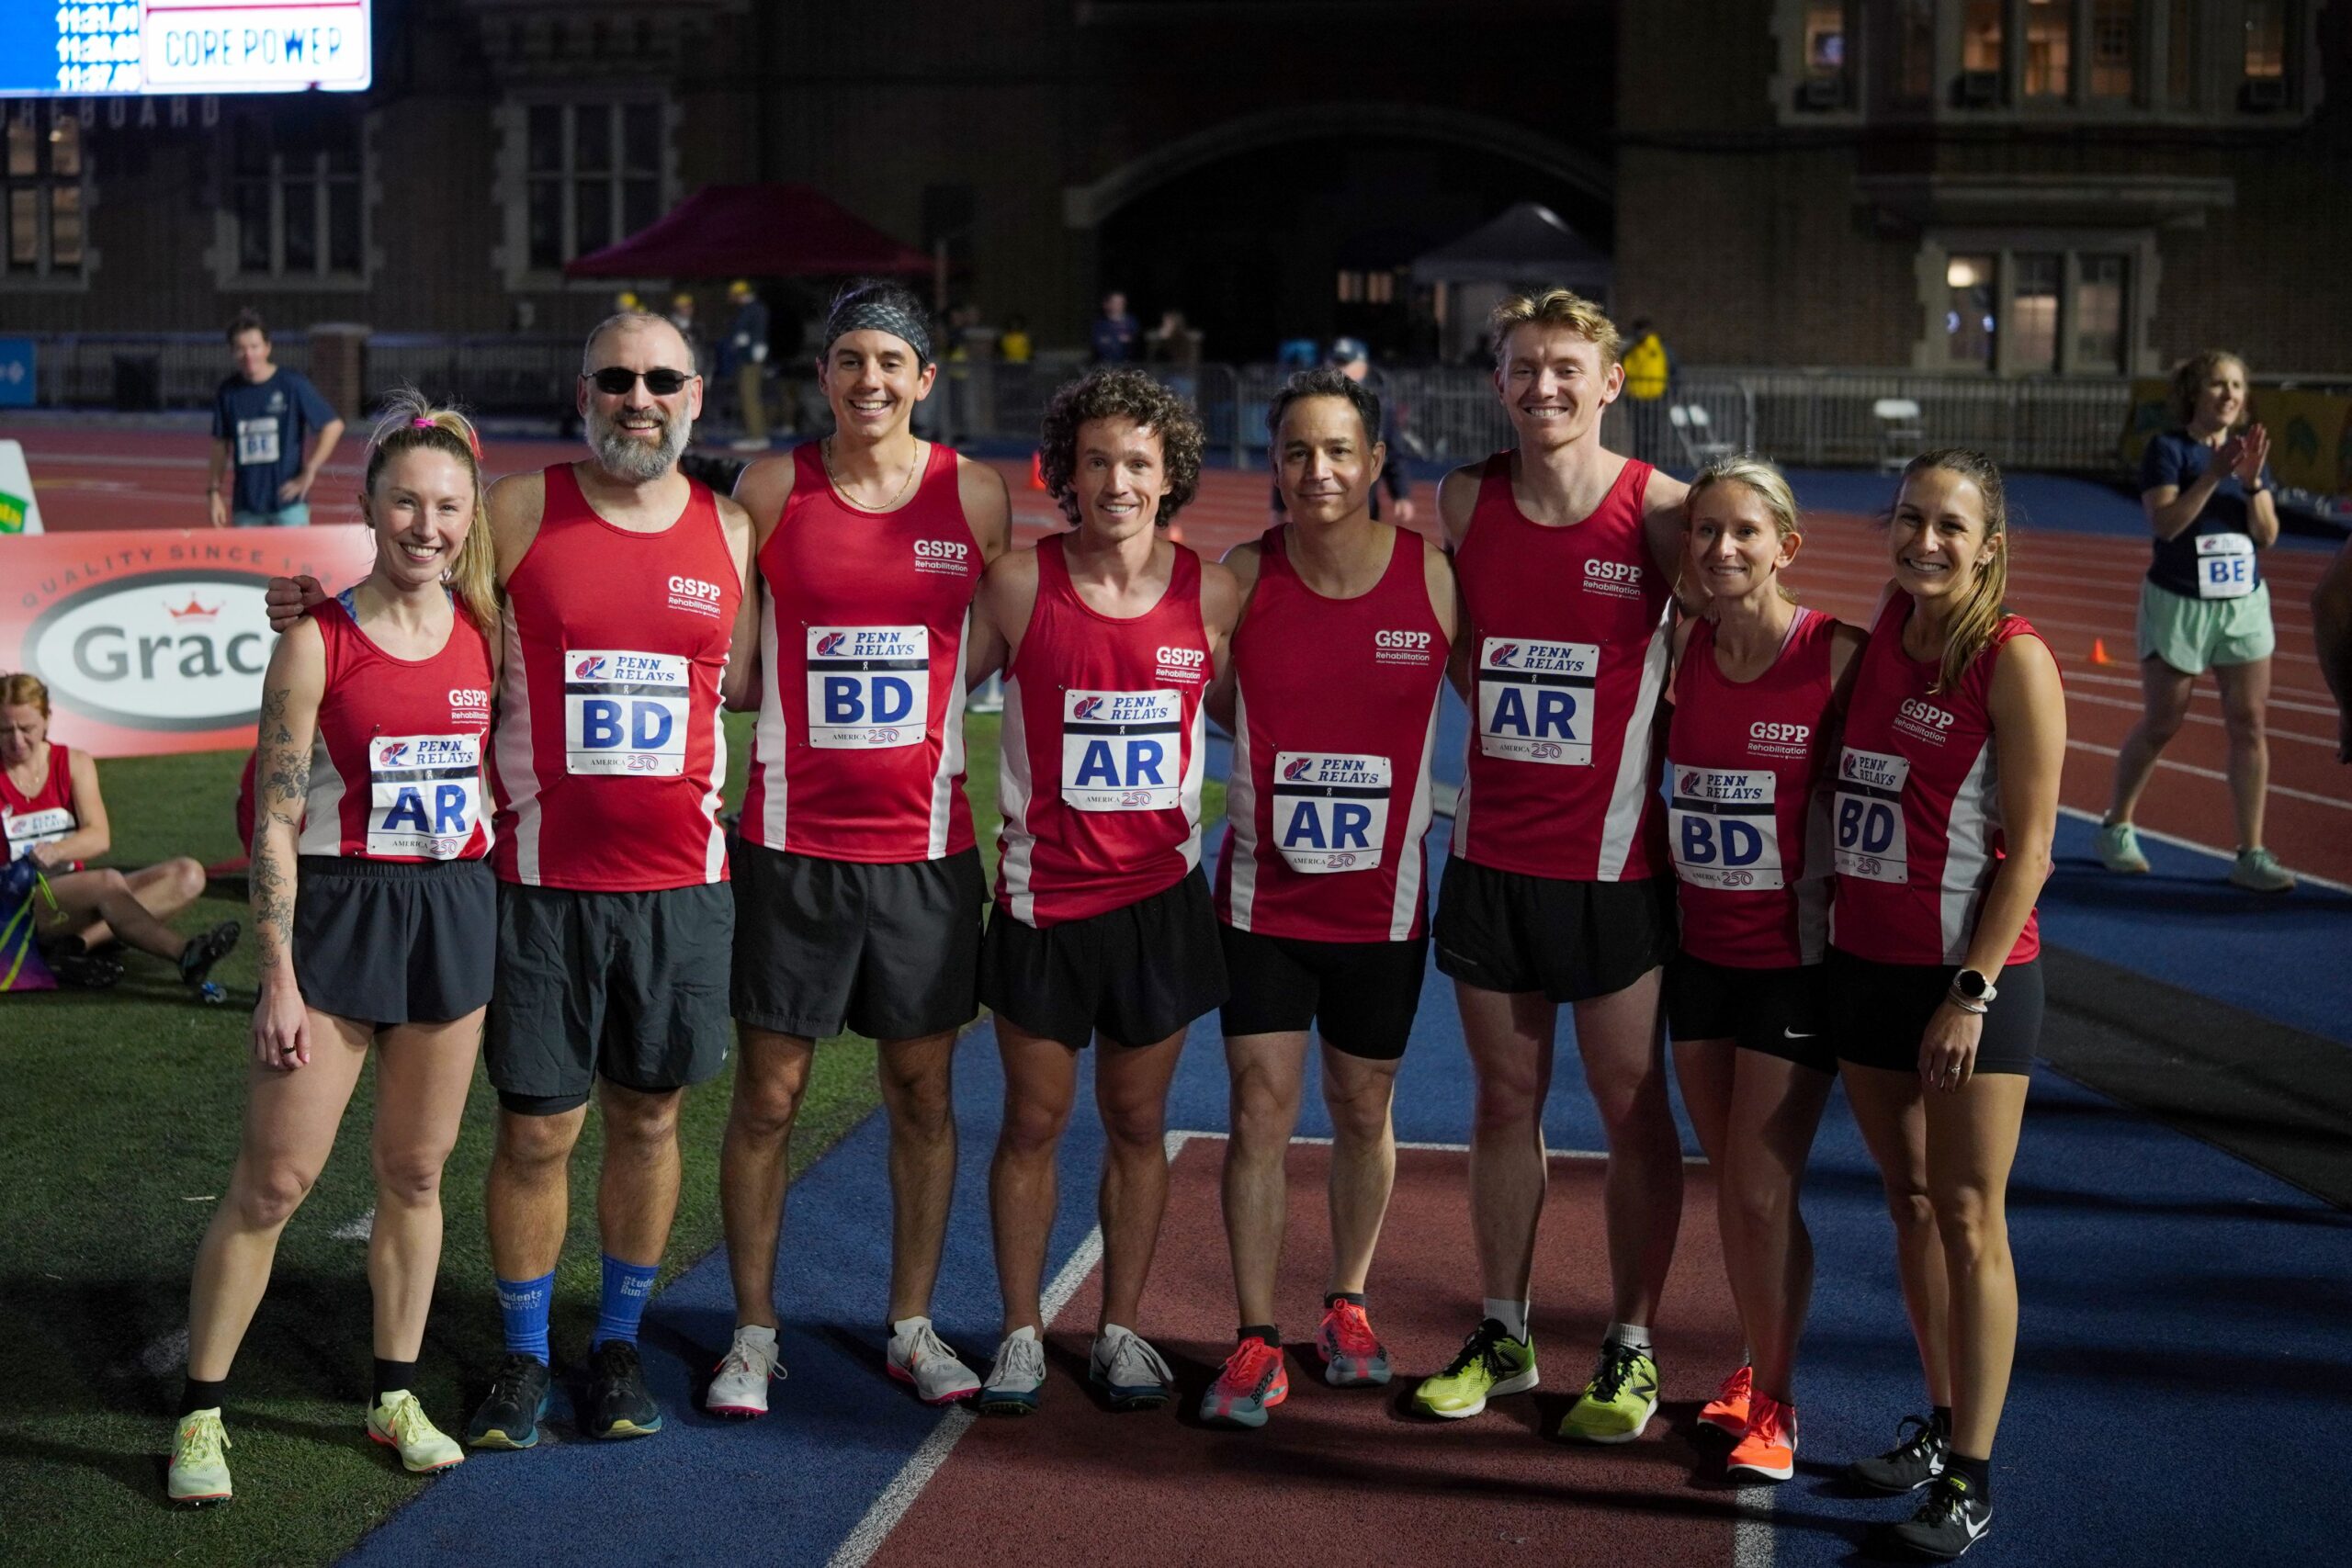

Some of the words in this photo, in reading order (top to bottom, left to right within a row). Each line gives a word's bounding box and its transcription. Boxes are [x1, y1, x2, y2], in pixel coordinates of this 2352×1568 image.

[165, 29, 233, 67] CORE
[243, 27, 342, 64] POWER
[913, 539, 968, 560] GSPP
[914, 559, 968, 572] Rehabilitation
[1584, 558, 1643, 583] GSPP
[2210, 559, 2245, 583] BE
[21, 547, 153, 609] QUALITY
[169, 545, 265, 564] SINCE
[668, 575, 721, 601] GSPP
[1582, 580, 1641, 596] Rehabilitation
[668, 596, 721, 615] Rehabilitation
[855, 632, 902, 643] PENN
[1374, 630, 1431, 649] GSPP
[72, 625, 277, 682] Grac
[853, 644, 915, 656] RELAYS
[1156, 646, 1204, 668] GSPP
[1375, 651, 1430, 661] Rehabilitation
[1527, 645, 1573, 659] PENN
[616, 656, 662, 671] PENN
[1523, 658, 1585, 671] RELAYS
[614, 671, 675, 682] RELAYS
[1155, 668, 1201, 680] Rehabilitation
[448, 689, 488, 707] GSPP
[825, 676, 913, 724] BD
[1113, 696, 1157, 708] PENN
[1110, 707, 1168, 720] RELAYS
[1489, 687, 1577, 740] AR
[1900, 697, 1955, 729] GSPP
[582, 700, 673, 750] BD
[1749, 721, 1810, 743] GSPP
[1894, 716, 1947, 743] Rehabilitation
[418, 741, 462, 752] PENN
[1499, 744, 1530, 753] AMERICA
[1747, 742, 1807, 755] Rehabilitation
[416, 751, 473, 765] RELAYS
[1074, 739, 1164, 786] AR
[1321, 759, 1366, 772] PENN
[1860, 756, 1888, 772] PENN
[1318, 771, 1379, 784] RELAYS
[1707, 774, 1748, 787] PENN
[1860, 770, 1896, 786] RELAYS
[1706, 786, 1762, 799] RELAYS
[381, 784, 467, 834] AR
[1283, 801, 1372, 850] AR
[1839, 798, 1894, 853] BD
[392, 840, 427, 849] AMERICA
[1682, 815, 1763, 866] BD
[1293, 855, 1326, 865] AMERICA
